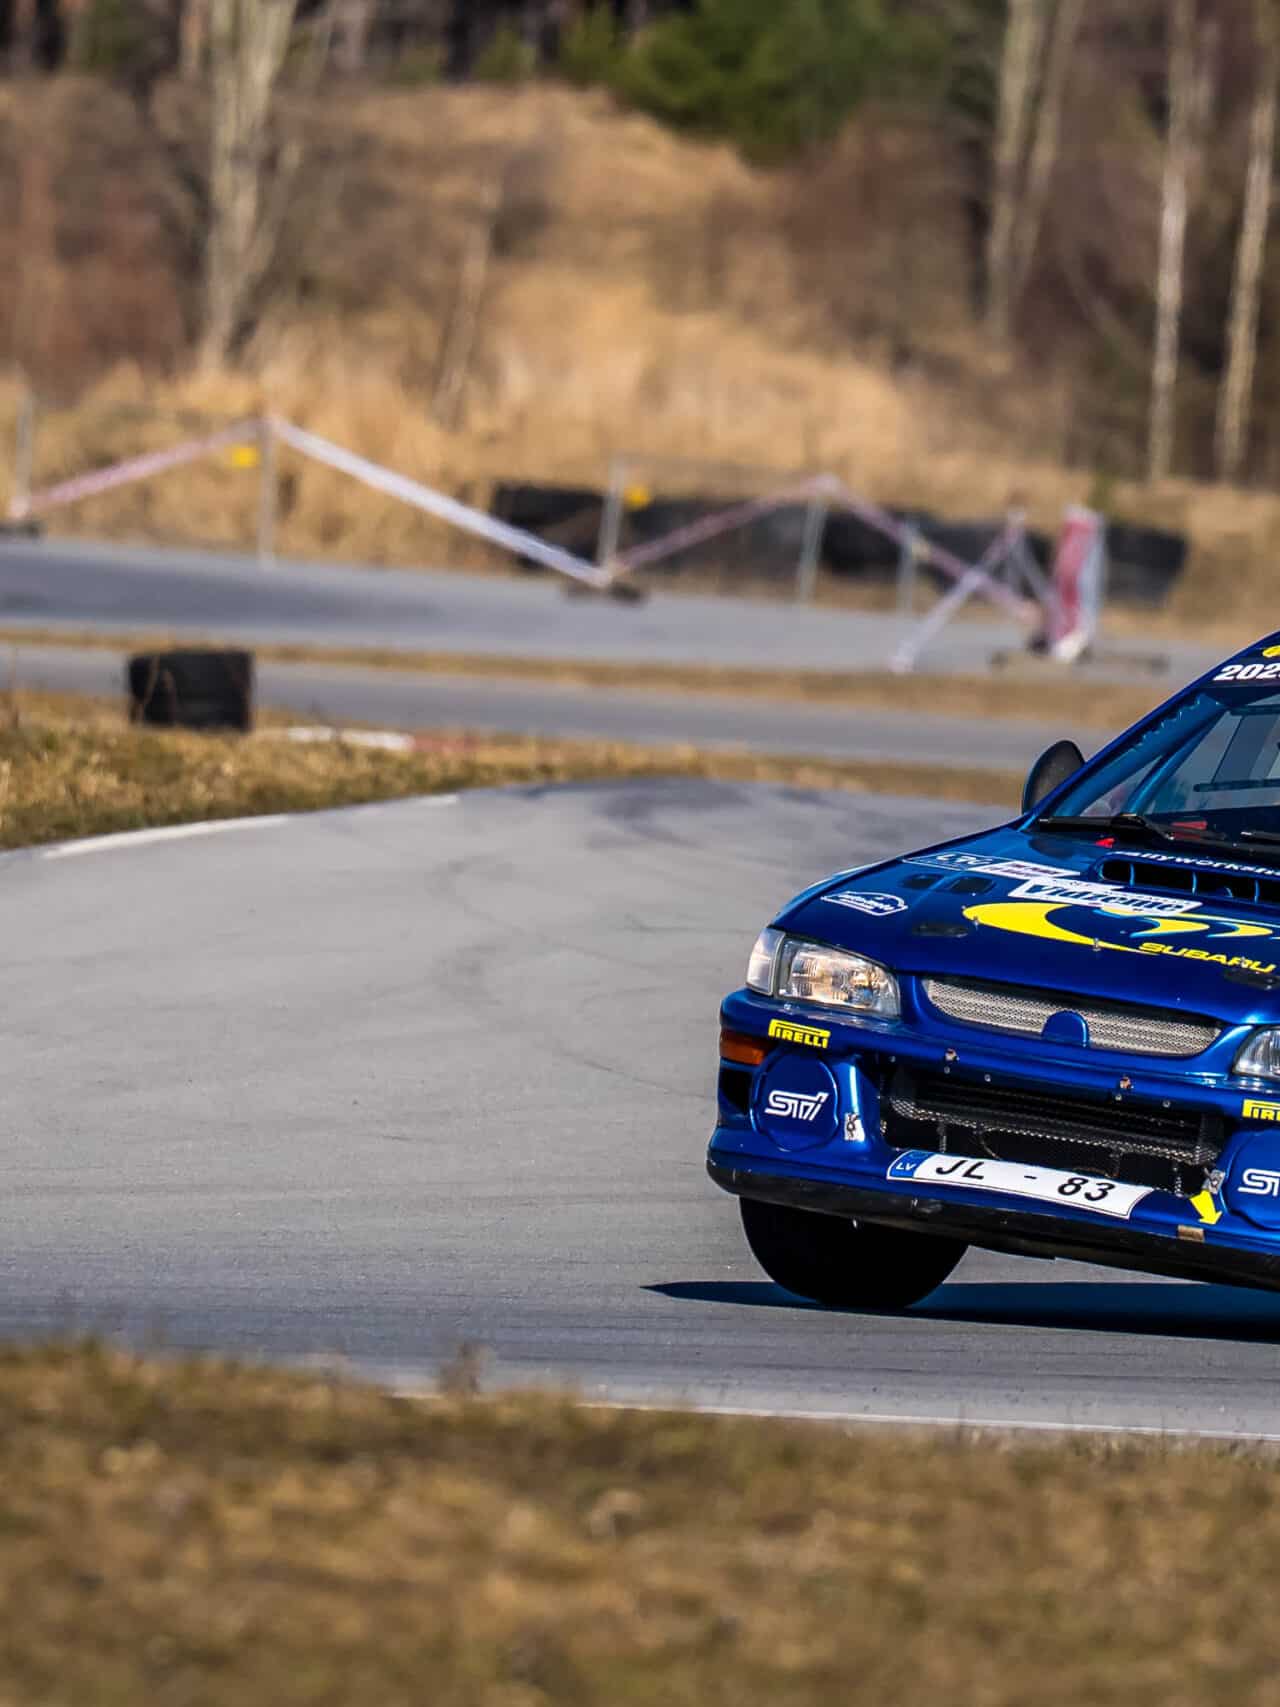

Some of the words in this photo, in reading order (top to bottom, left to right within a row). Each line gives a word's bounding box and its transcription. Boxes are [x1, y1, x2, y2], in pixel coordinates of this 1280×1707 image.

[1024, 883, 1185, 913] Vidzeme
[1138, 942, 1277, 974] SUBARU
[768, 1018, 831, 1049] PIRELLI
[895, 1161, 916, 1171] LV
[935, 1159, 985, 1180] JL
[1057, 1177, 1116, 1202] 83
